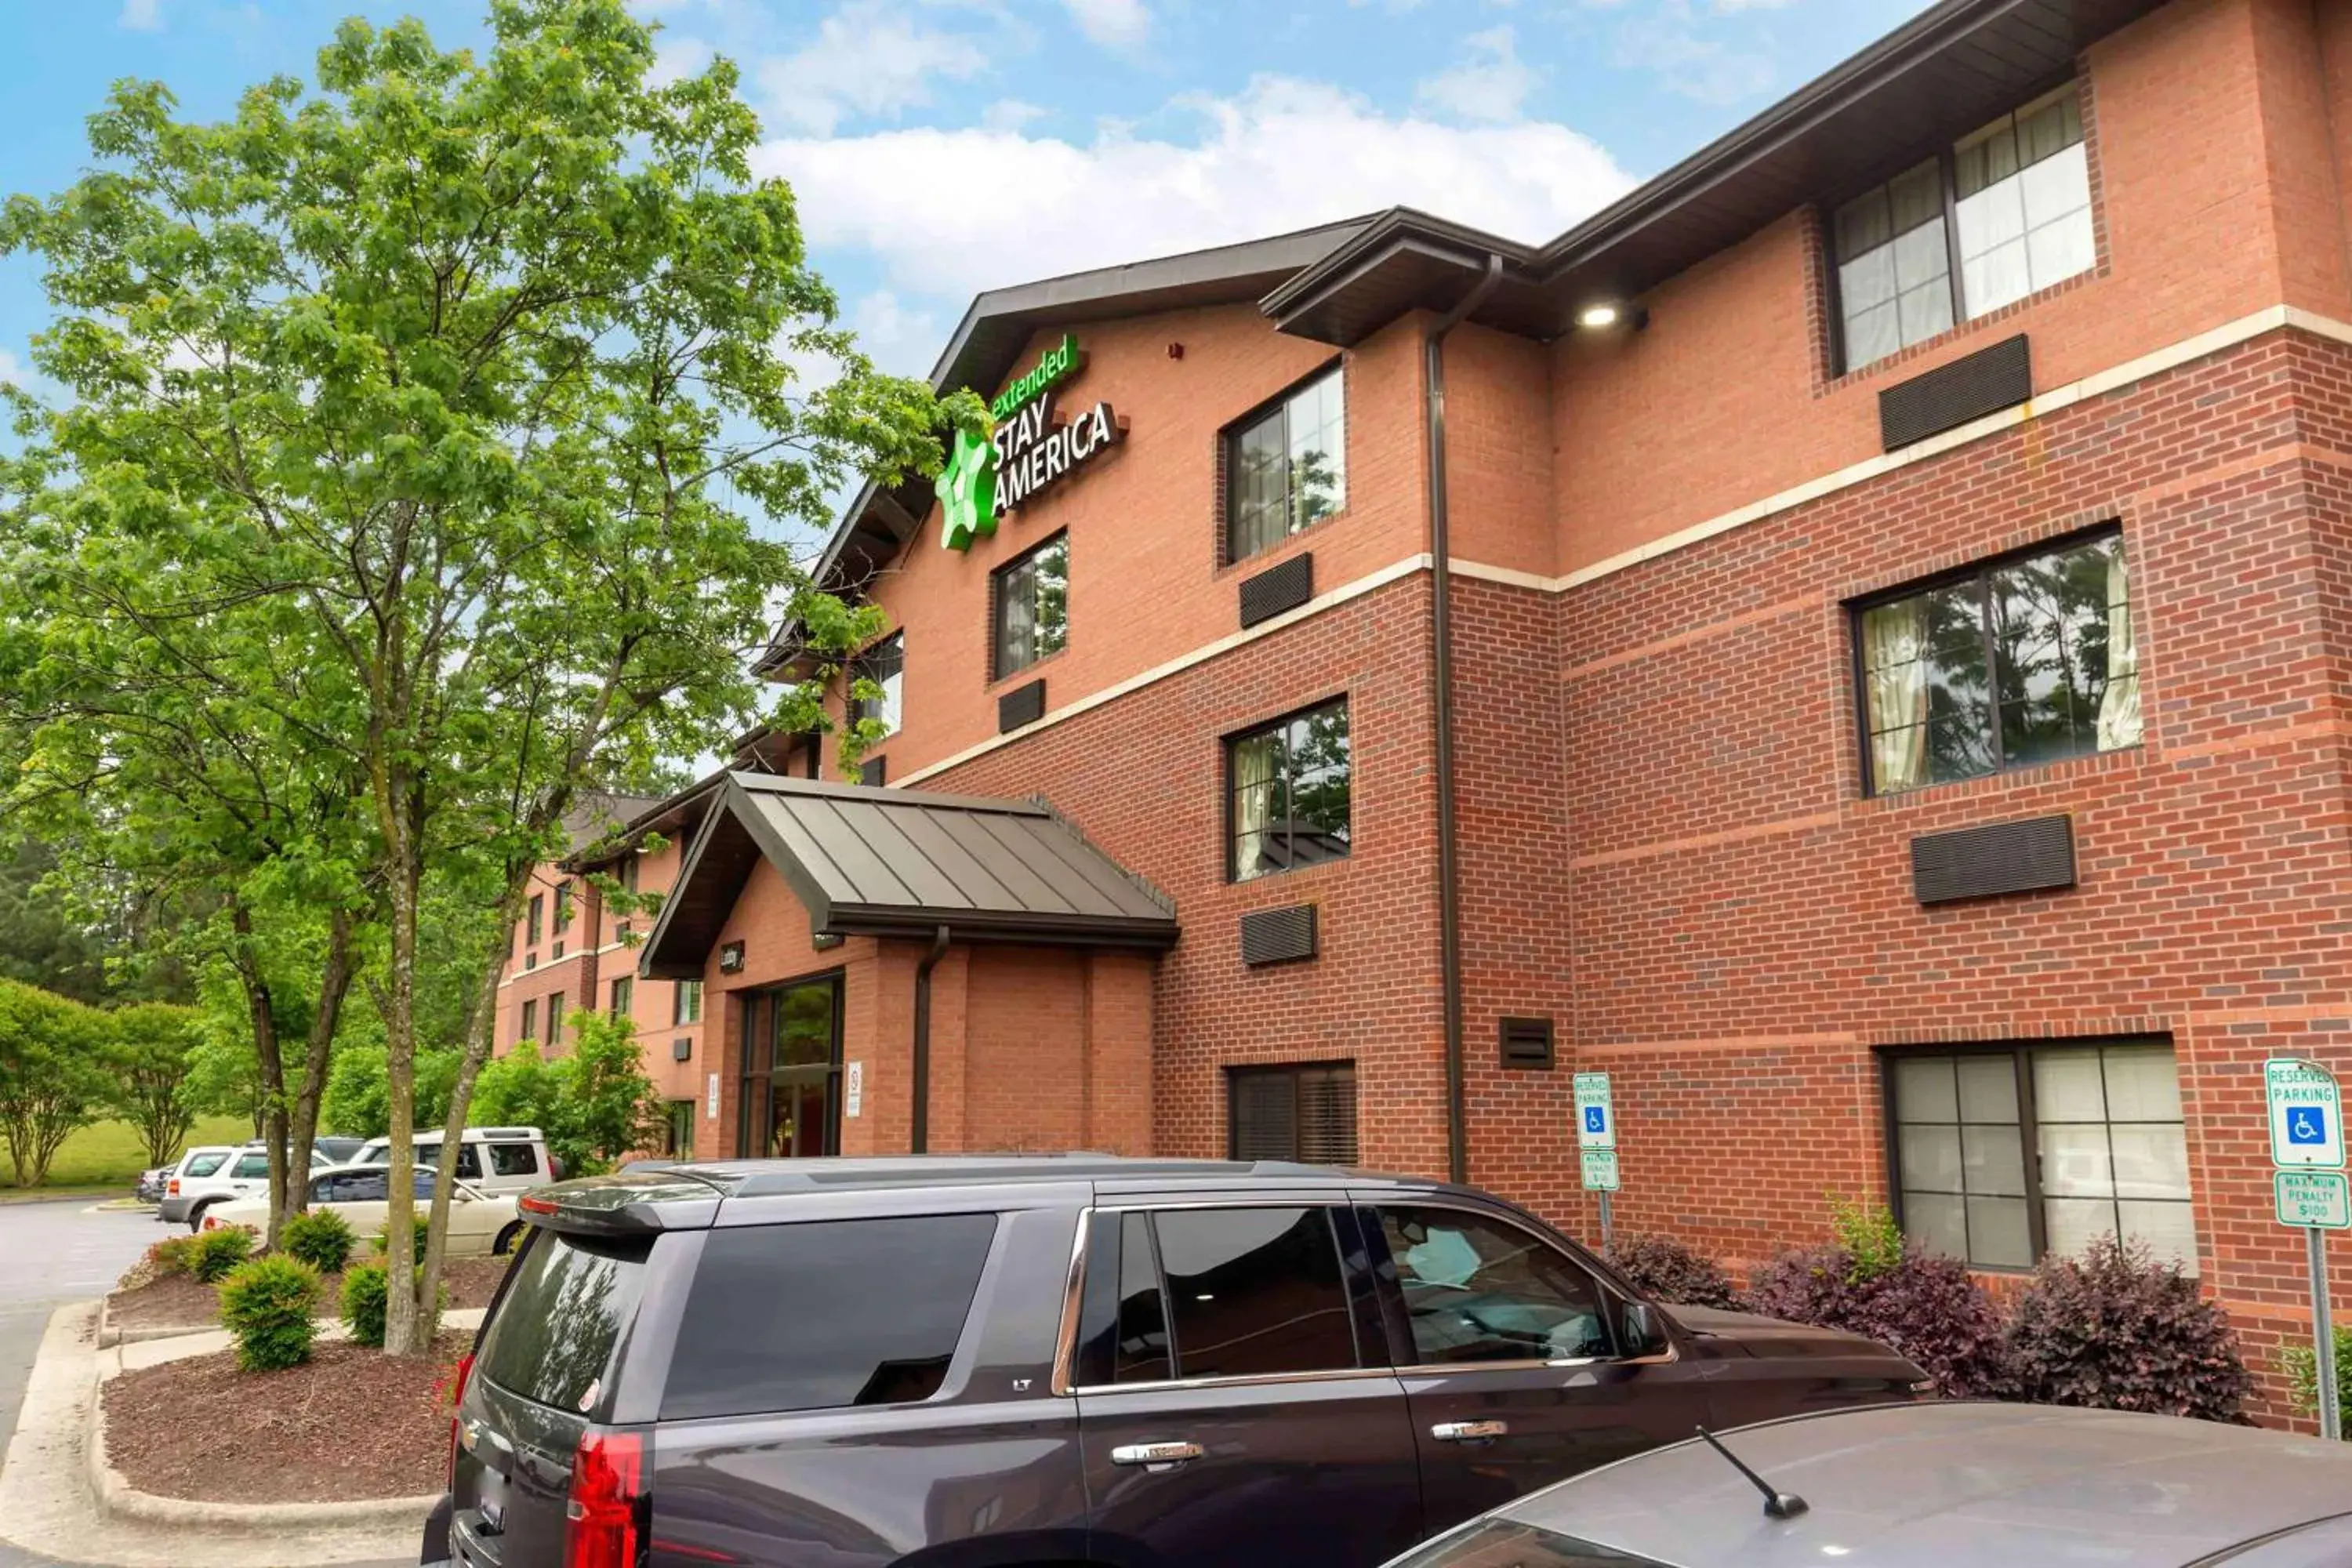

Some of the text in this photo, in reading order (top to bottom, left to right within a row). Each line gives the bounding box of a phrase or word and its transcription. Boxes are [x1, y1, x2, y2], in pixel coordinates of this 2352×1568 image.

[992, 333, 1068, 420] extended
[992, 393, 1048, 471] STAY
[991, 402, 1111, 517] AMERICA
[2270, 1070, 2332, 1083] RESERVED
[2274, 1088, 2332, 1101] PARKING
[2285, 1177, 2336, 1187] MAXIMUM
[2288, 1191, 2334, 1202] PENALTY
[2299, 1205, 2328, 1217] $100
[1013, 1379, 1032, 1391] LT
